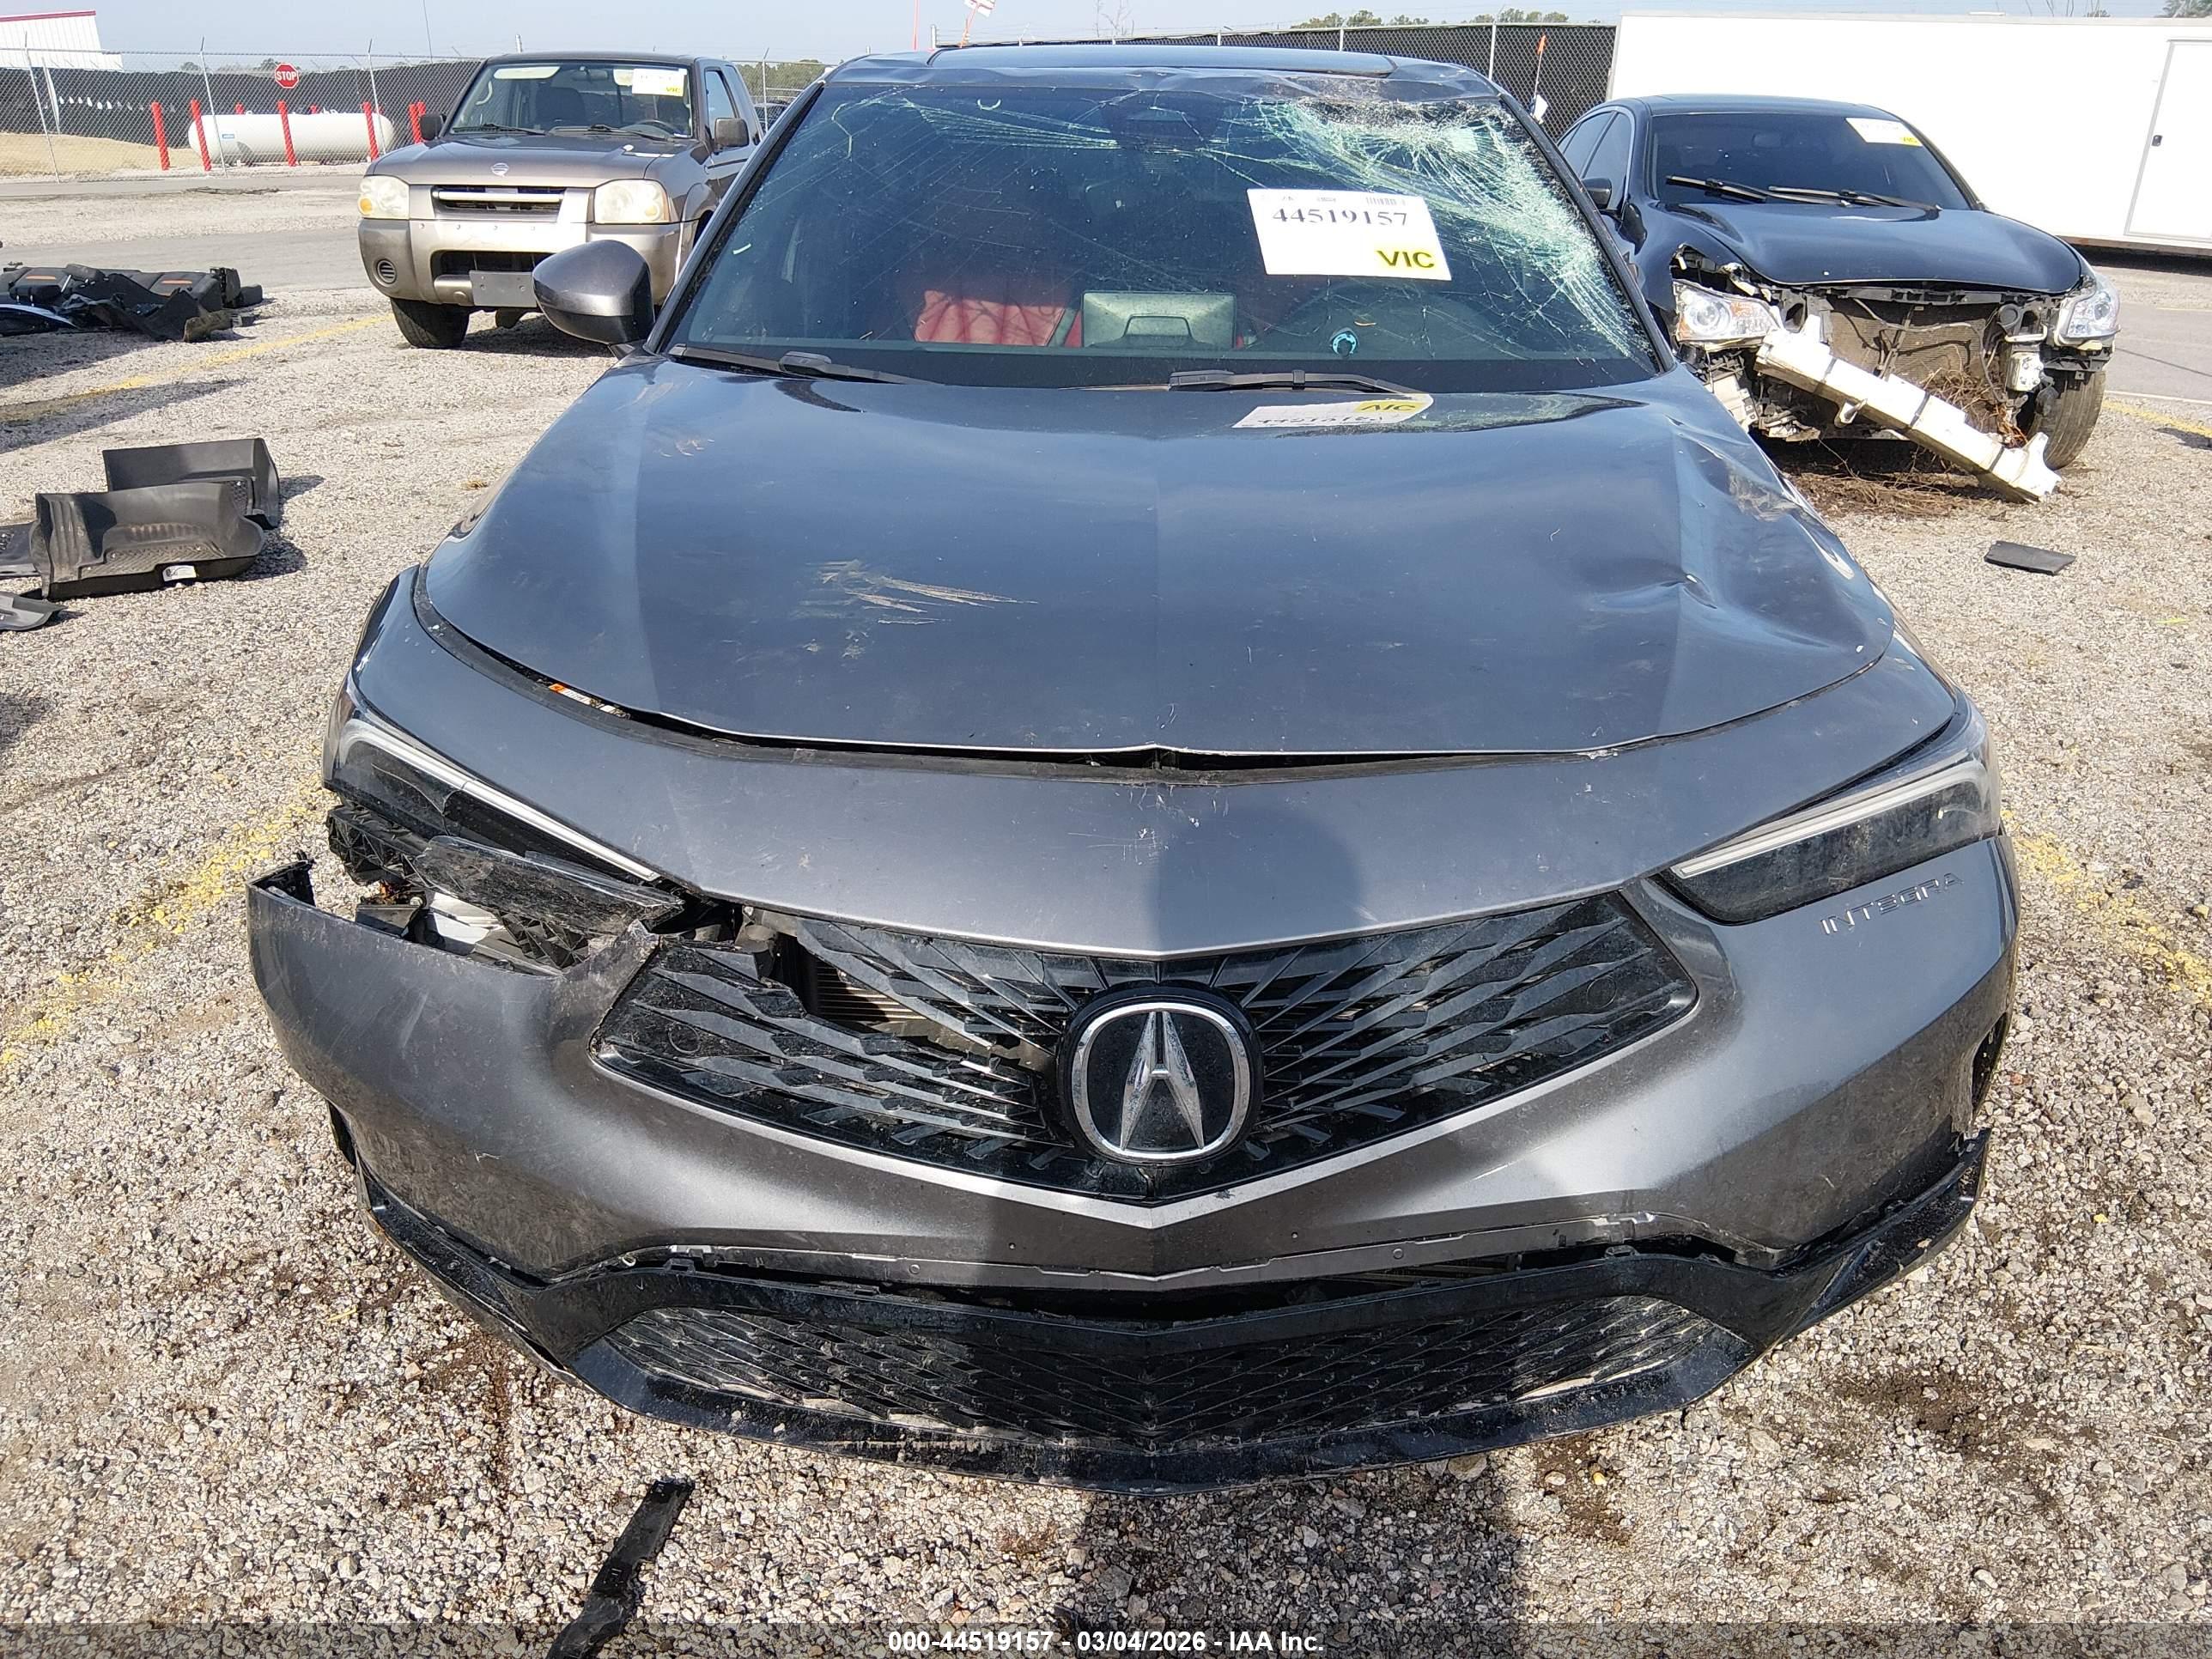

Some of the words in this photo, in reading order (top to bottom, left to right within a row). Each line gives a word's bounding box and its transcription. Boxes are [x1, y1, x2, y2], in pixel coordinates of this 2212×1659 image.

[276, 70, 297, 82] STOP
[1272, 208, 1408, 226] 44519157
[1376, 249, 1436, 269] VIC
[1820, 872, 1966, 935] INTEGRA
